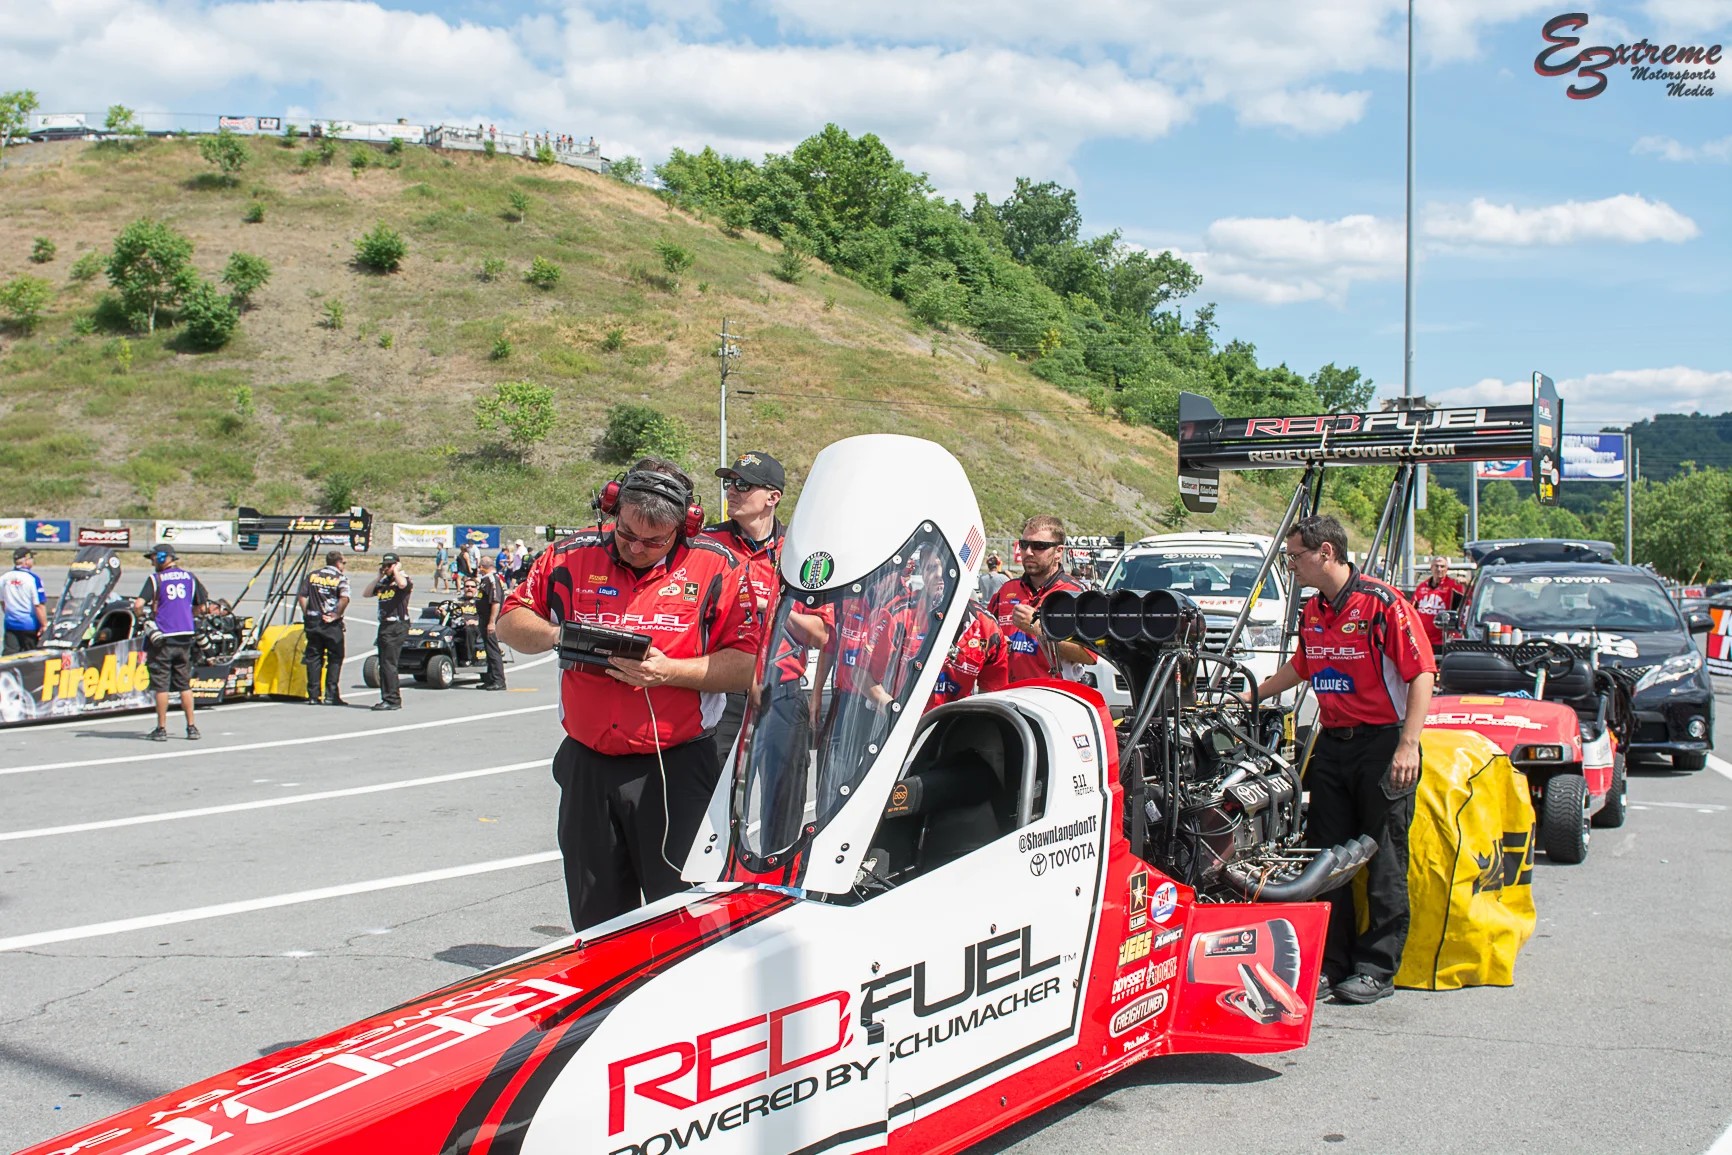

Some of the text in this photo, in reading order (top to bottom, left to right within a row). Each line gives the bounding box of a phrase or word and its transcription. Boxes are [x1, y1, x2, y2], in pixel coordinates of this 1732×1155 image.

[1245, 414, 1361, 437] RED
[1363, 408, 1511, 432] FUEL
[1248, 443, 1456, 462] REDFUELPOWER.COM
[161, 571, 191, 582] MEDIA
[166, 583, 186, 600] 96
[623, 613, 690, 627] FUEL
[1323, 647, 1365, 656] FUEL
[42, 651, 150, 701] FireAde
[1314, 677, 1350, 691] LOWE'S
[1074, 735, 1090, 748] FOX
[1073, 774, 1087, 789] 5.11
[1019, 815, 1097, 853] @ShawnLangdonTF
[1048, 842, 1096, 869] TOYOTA
[1119, 930, 1153, 967] JEGS
[1111, 982, 1145, 1004] BATTERY
[1112, 967, 1147, 995] ODYSSEY
[1115, 994, 1163, 1031] FREIGHTLINER
[608, 990, 853, 1137] RED
[861, 925, 1061, 1046] FUEL
[826, 1056, 881, 1091] BY
